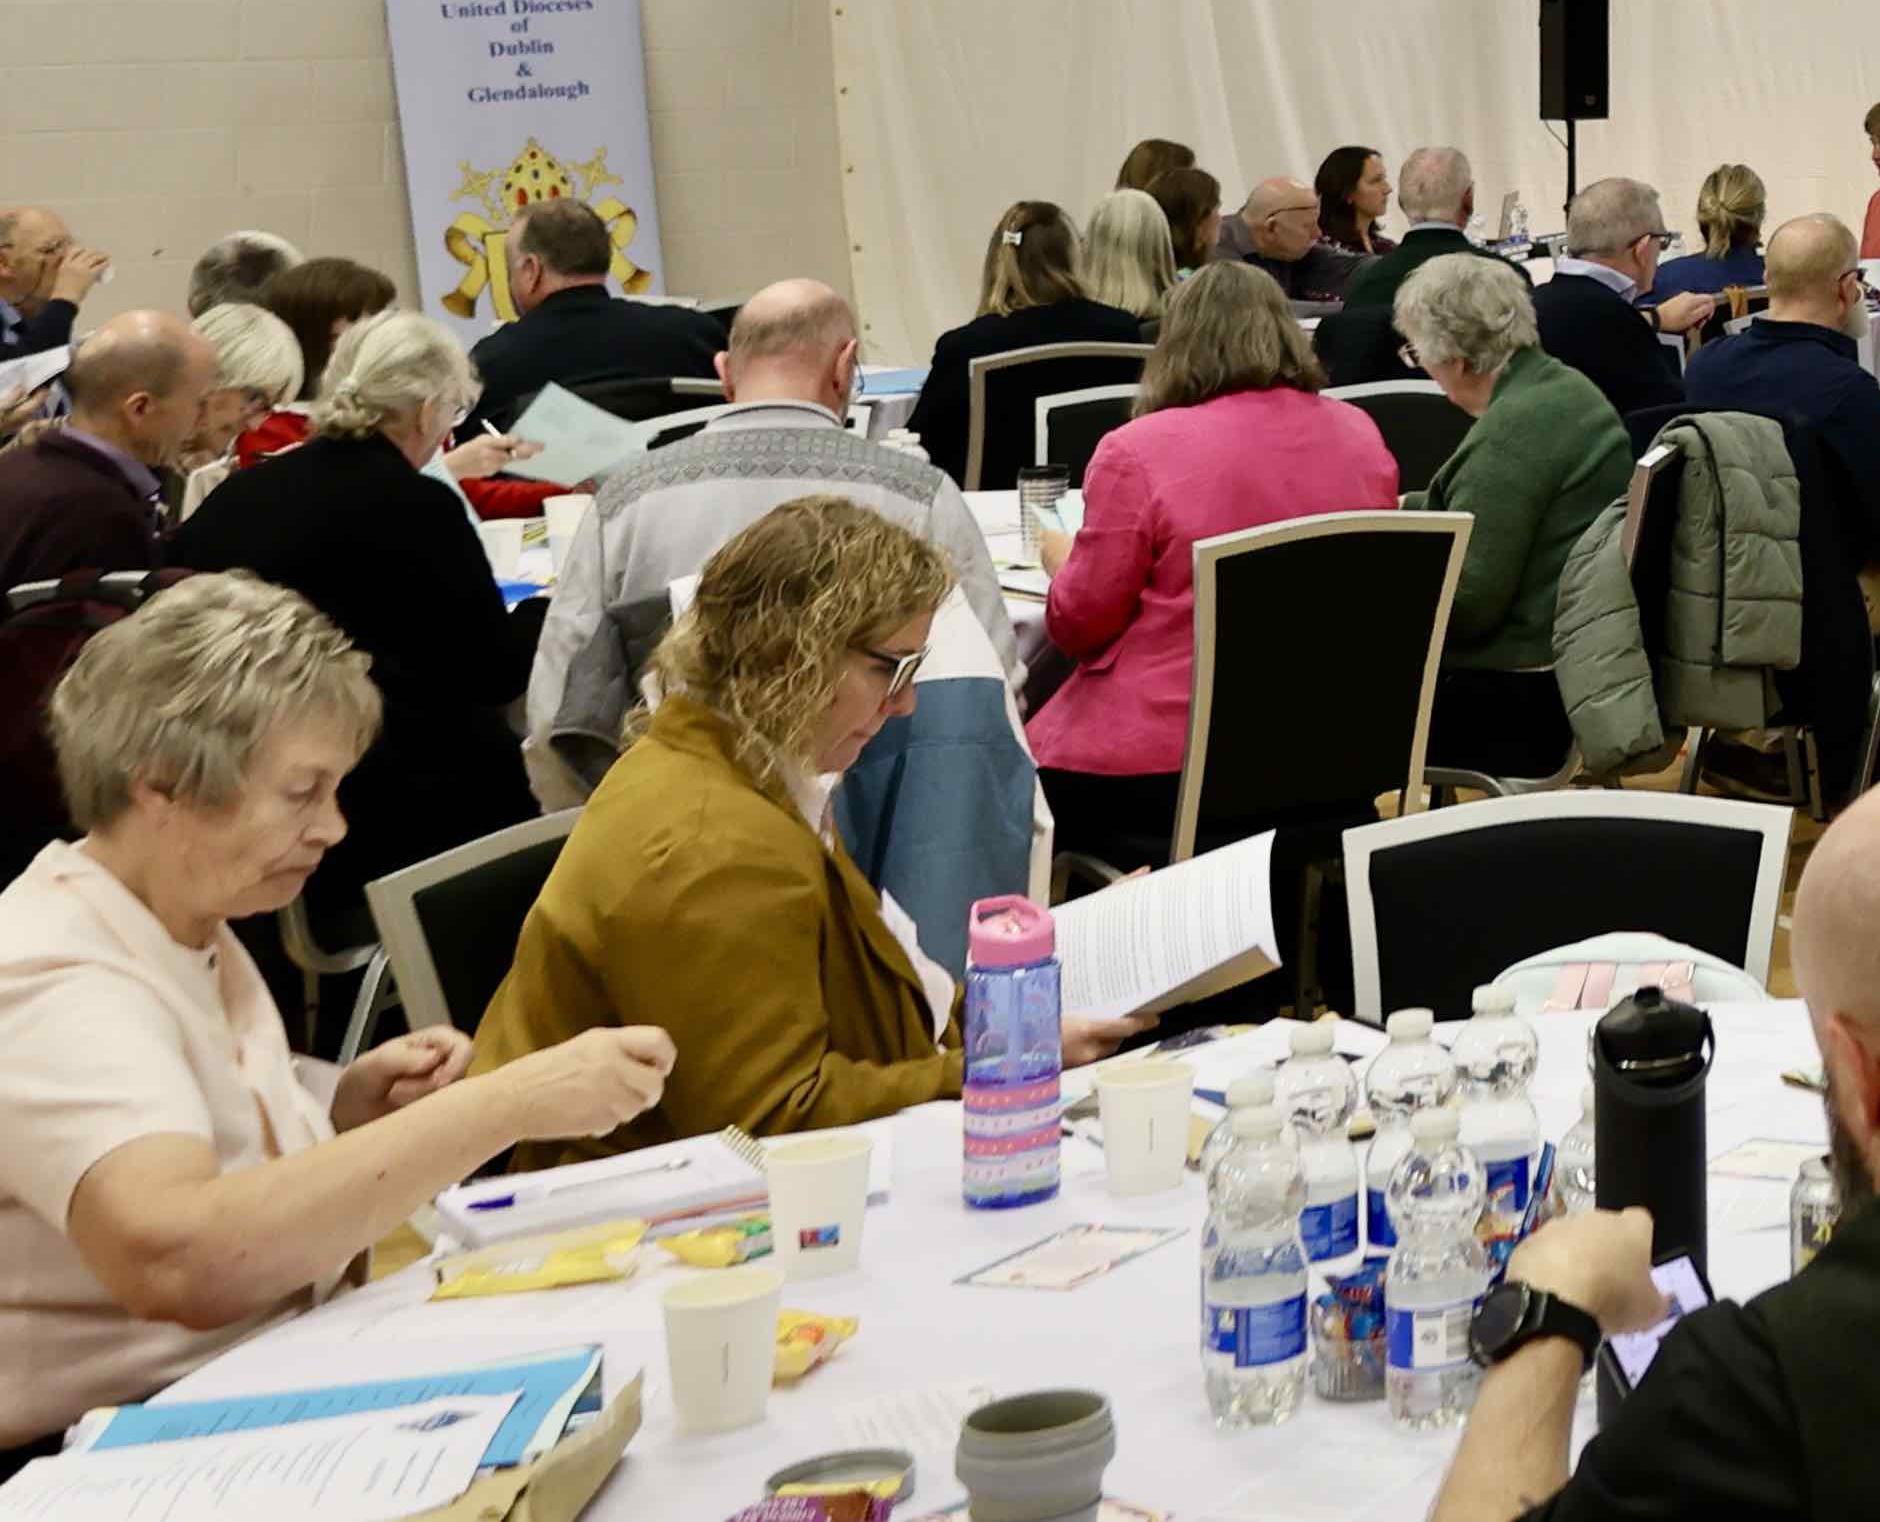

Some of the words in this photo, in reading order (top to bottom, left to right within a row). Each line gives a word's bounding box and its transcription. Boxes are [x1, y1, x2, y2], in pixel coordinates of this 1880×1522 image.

[441, 0, 507, 20] United
[510, 17, 530, 34] of
[489, 39, 555, 59] Dublin
[515, 61, 533, 79] &
[467, 80, 590, 104] Glendalough
